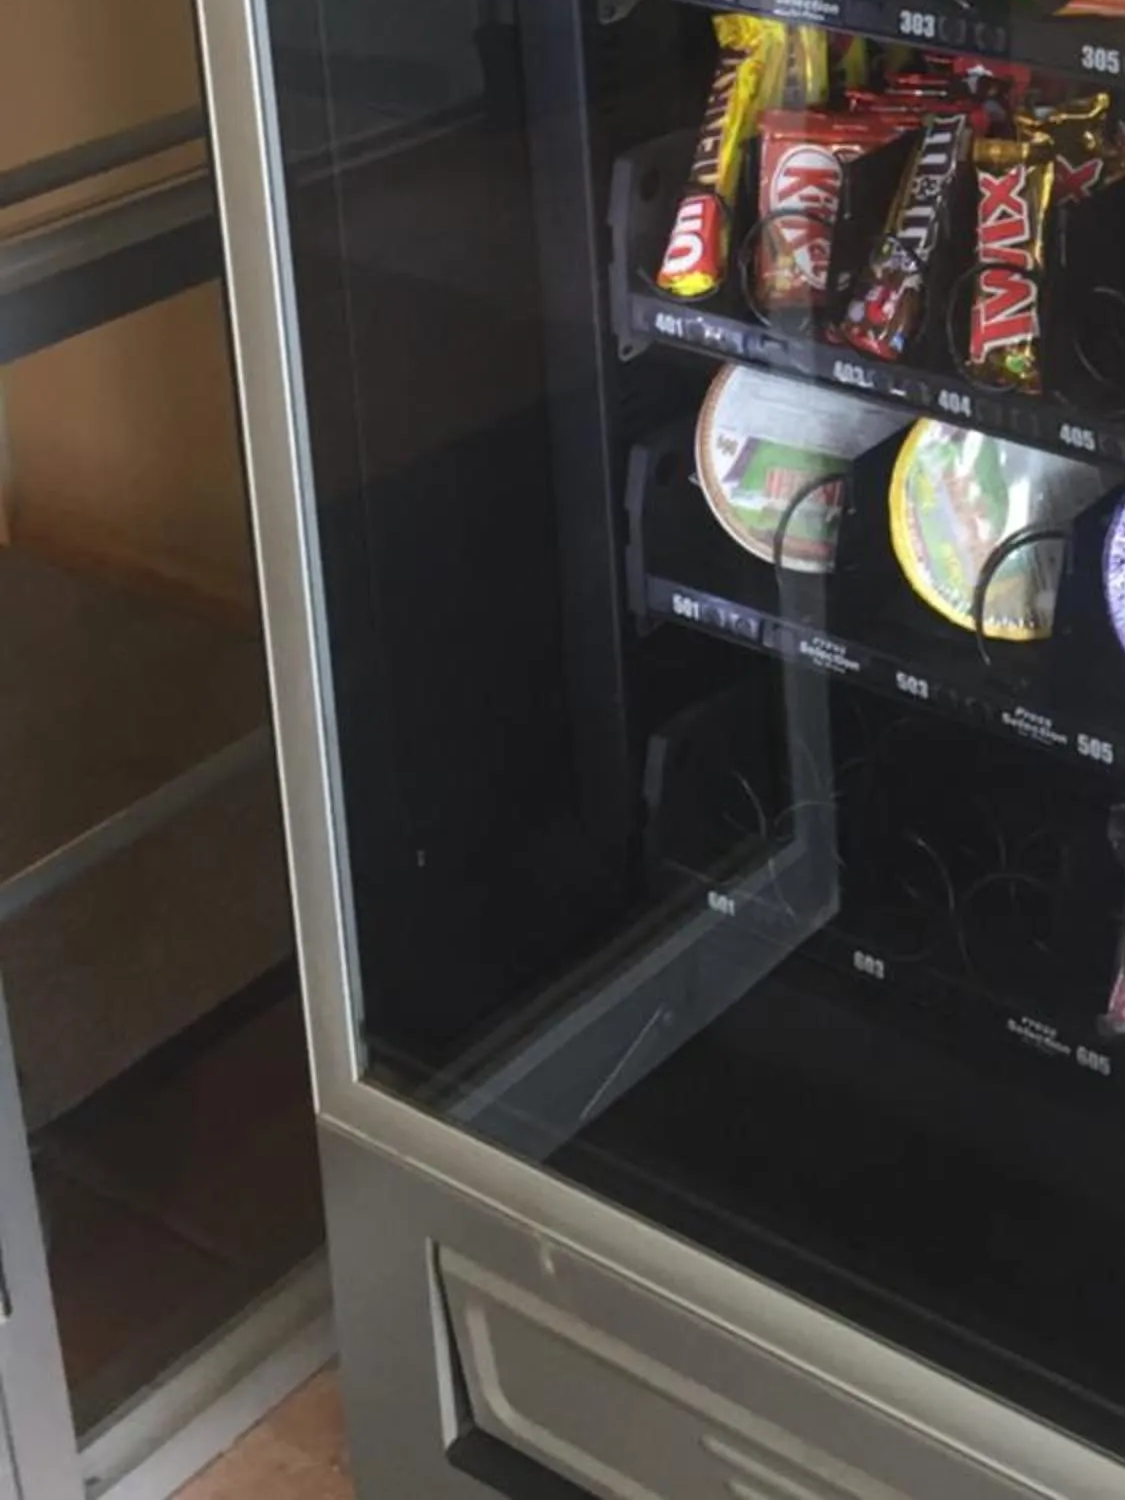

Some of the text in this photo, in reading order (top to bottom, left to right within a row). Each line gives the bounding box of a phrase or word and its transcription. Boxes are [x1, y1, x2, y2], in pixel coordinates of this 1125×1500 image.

[900, 10, 935, 38] 303
[1081, 45, 1120, 74] 305
[969, 164, 1040, 364] TWIX
[938, 389, 972, 418] 404
[1060, 423, 1096, 451] 405
[1077, 733, 1114, 764] 505
